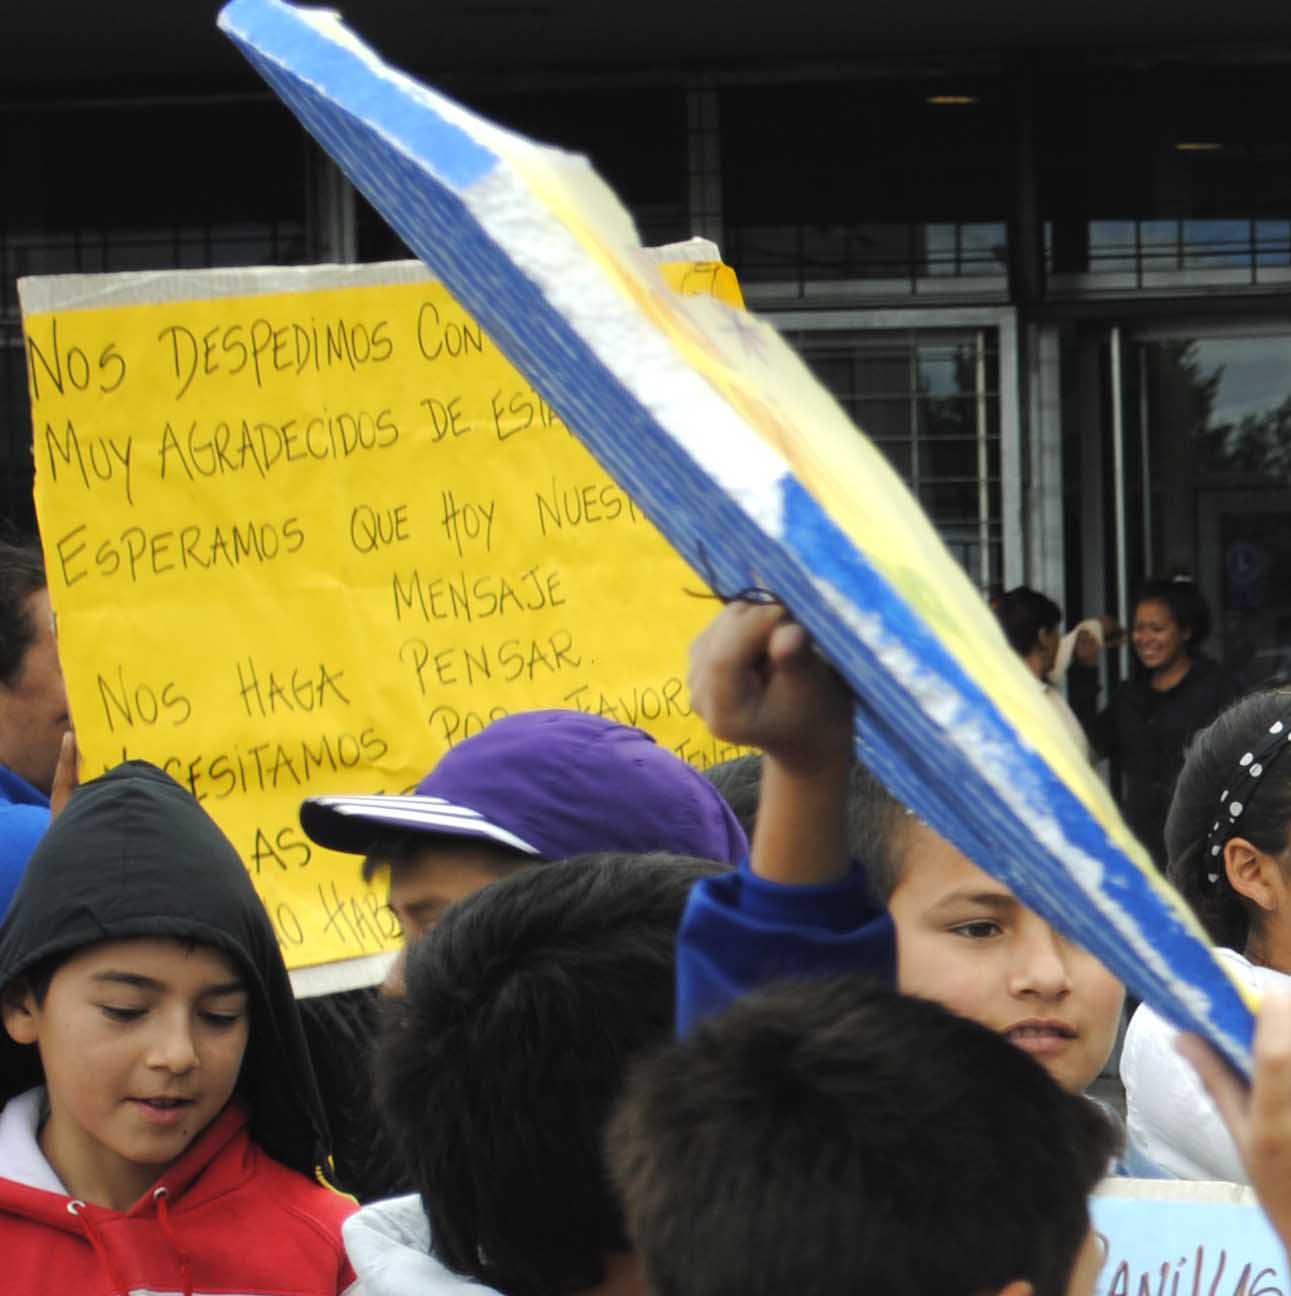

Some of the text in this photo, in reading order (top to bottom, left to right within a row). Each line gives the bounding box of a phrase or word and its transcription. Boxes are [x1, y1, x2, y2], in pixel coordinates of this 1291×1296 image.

[28, 317, 127, 400] NOS
[45, 422, 133, 503] MUY
[421, 397, 471, 443] DE
[57, 517, 305, 587] ESPERAMOS
[350, 504, 410, 555] QUE
[442, 490, 495, 558] HOY
[392, 569, 567, 624] MENSAJE
[97, 667, 191, 733] NOS
[237, 656, 350, 718] HAGA
